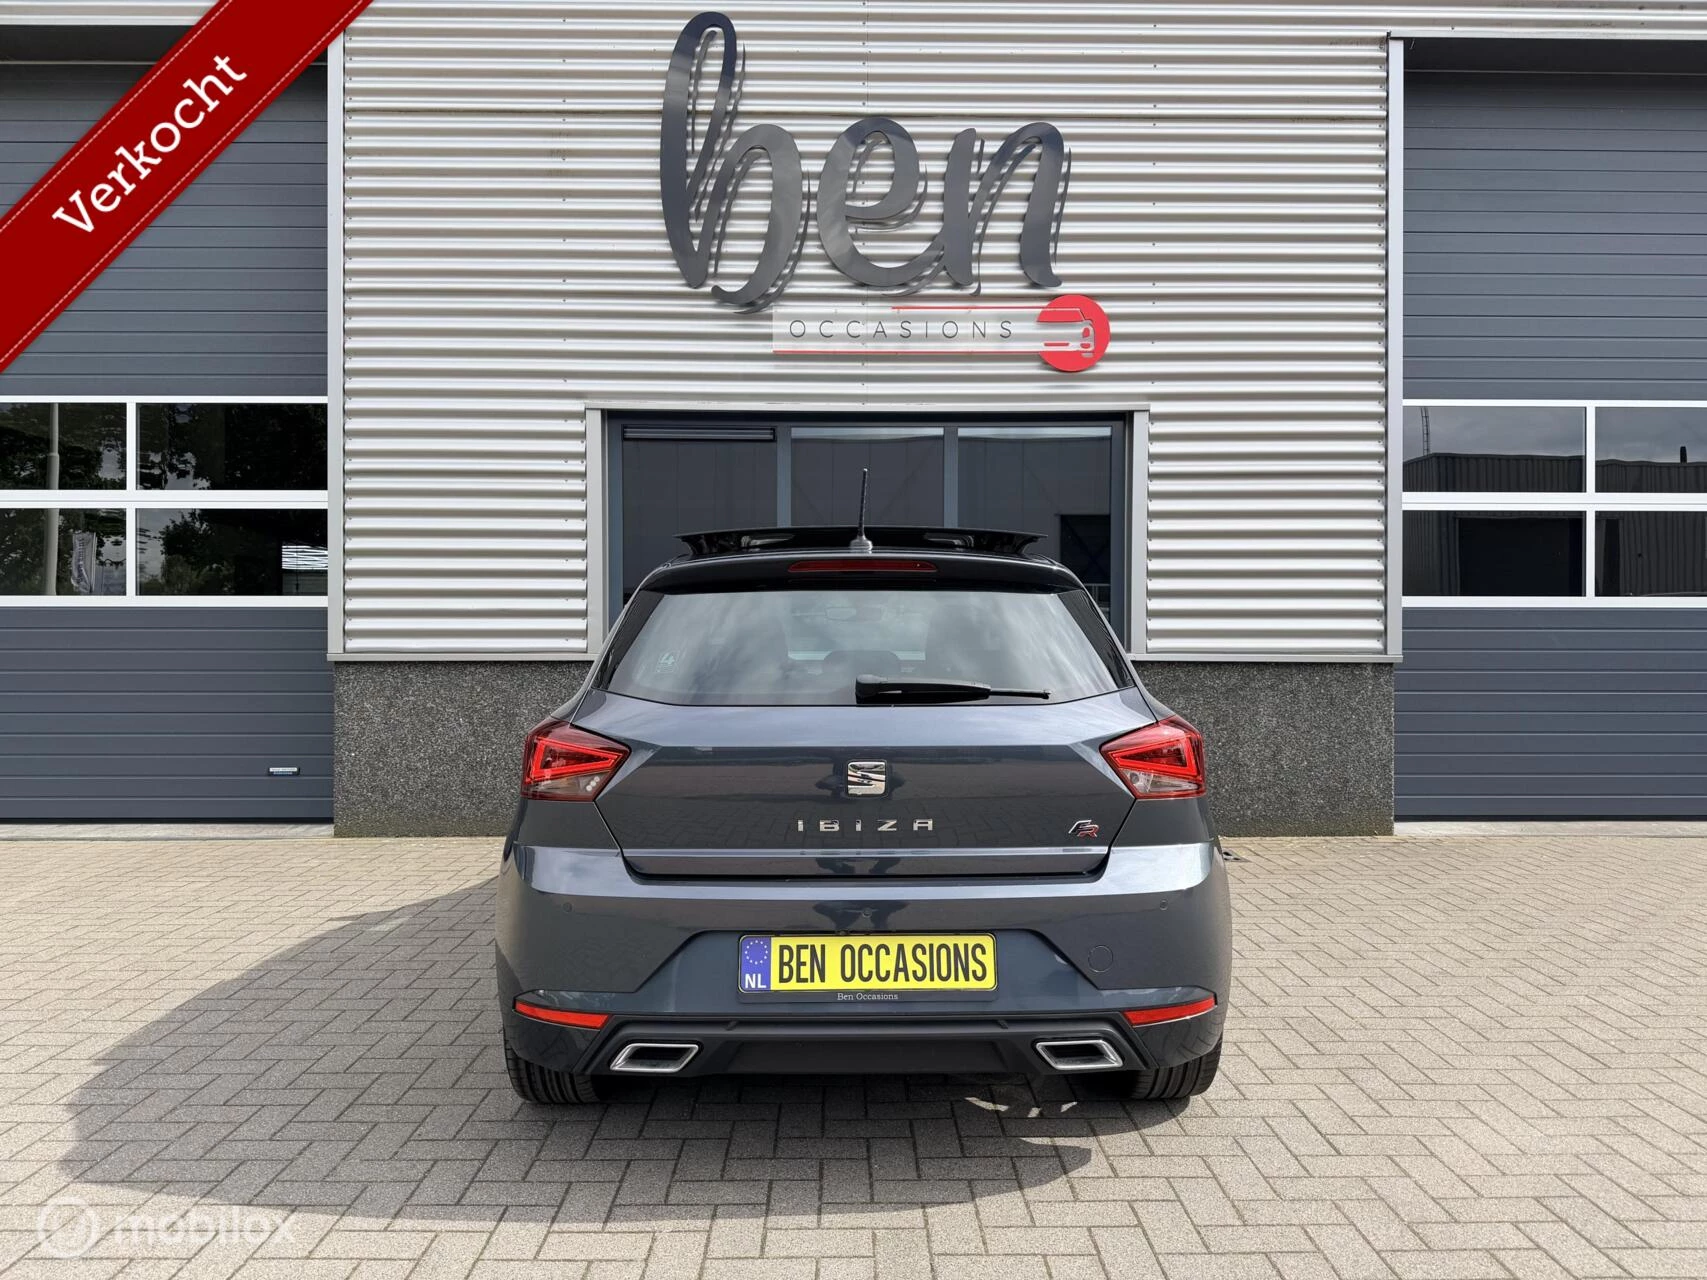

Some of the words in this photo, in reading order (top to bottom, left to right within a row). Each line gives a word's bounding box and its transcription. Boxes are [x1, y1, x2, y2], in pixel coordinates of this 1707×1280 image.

[660, 11, 1065, 304] ben
[789, 319, 1013, 338] OCCASIONS
[797, 819, 933, 832] IBIZA
[1068, 819, 1100, 838] FR
[778, 943, 826, 983] BEN
[840, 943, 987, 982] OCCASIONS
[744, 973, 767, 989] NL
[837, 992, 854, 1001] Ben
[856, 992, 898, 1001] Occasions
